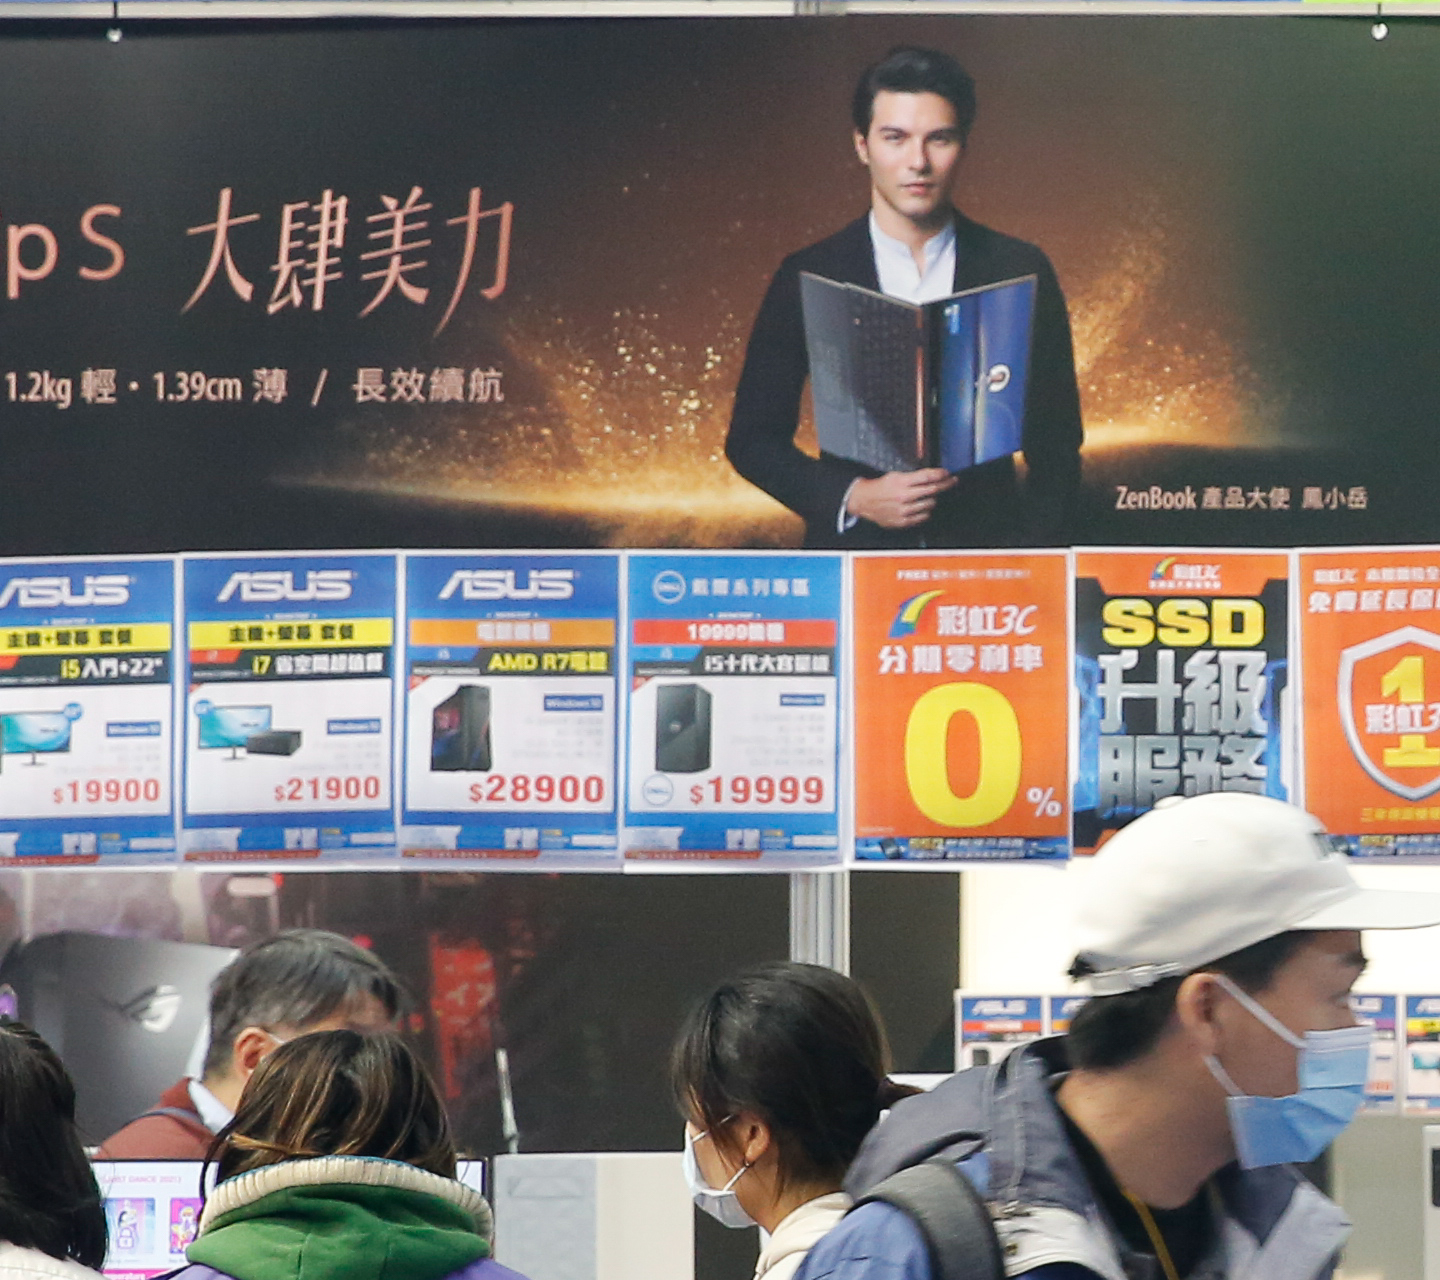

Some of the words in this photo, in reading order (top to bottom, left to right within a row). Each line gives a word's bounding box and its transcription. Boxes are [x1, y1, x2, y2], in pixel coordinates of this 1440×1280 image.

[79, 203, 125, 281] S
[179, 185, 515, 337] 大肆美力
[6, 371, 73, 409] 1.2kg
[154, 370, 242, 403] 1.39cm
[354, 368, 505, 405] 長效續航
[1115, 484, 1198, 511] ZenBook
[1201, 485, 1291, 511] 產品大使
[216, 570, 353, 602] ASUS
[438, 569, 575, 600] ASUS
[936, 604, 1039, 637] 彩虹3C
[1101, 598, 1265, 648] SSD
[487, 652, 538, 673] AMD
[879, 643, 1043, 675] 分期零利率
[1097, 648, 1268, 735] 升級
[904, 680, 1024, 829] 0
[1026, 786, 1063, 818] %
[53, 779, 159, 805] $19900
[274, 776, 379, 804] $21900
[468, 774, 603, 804] $28900
[691, 776, 823, 804] $19999
